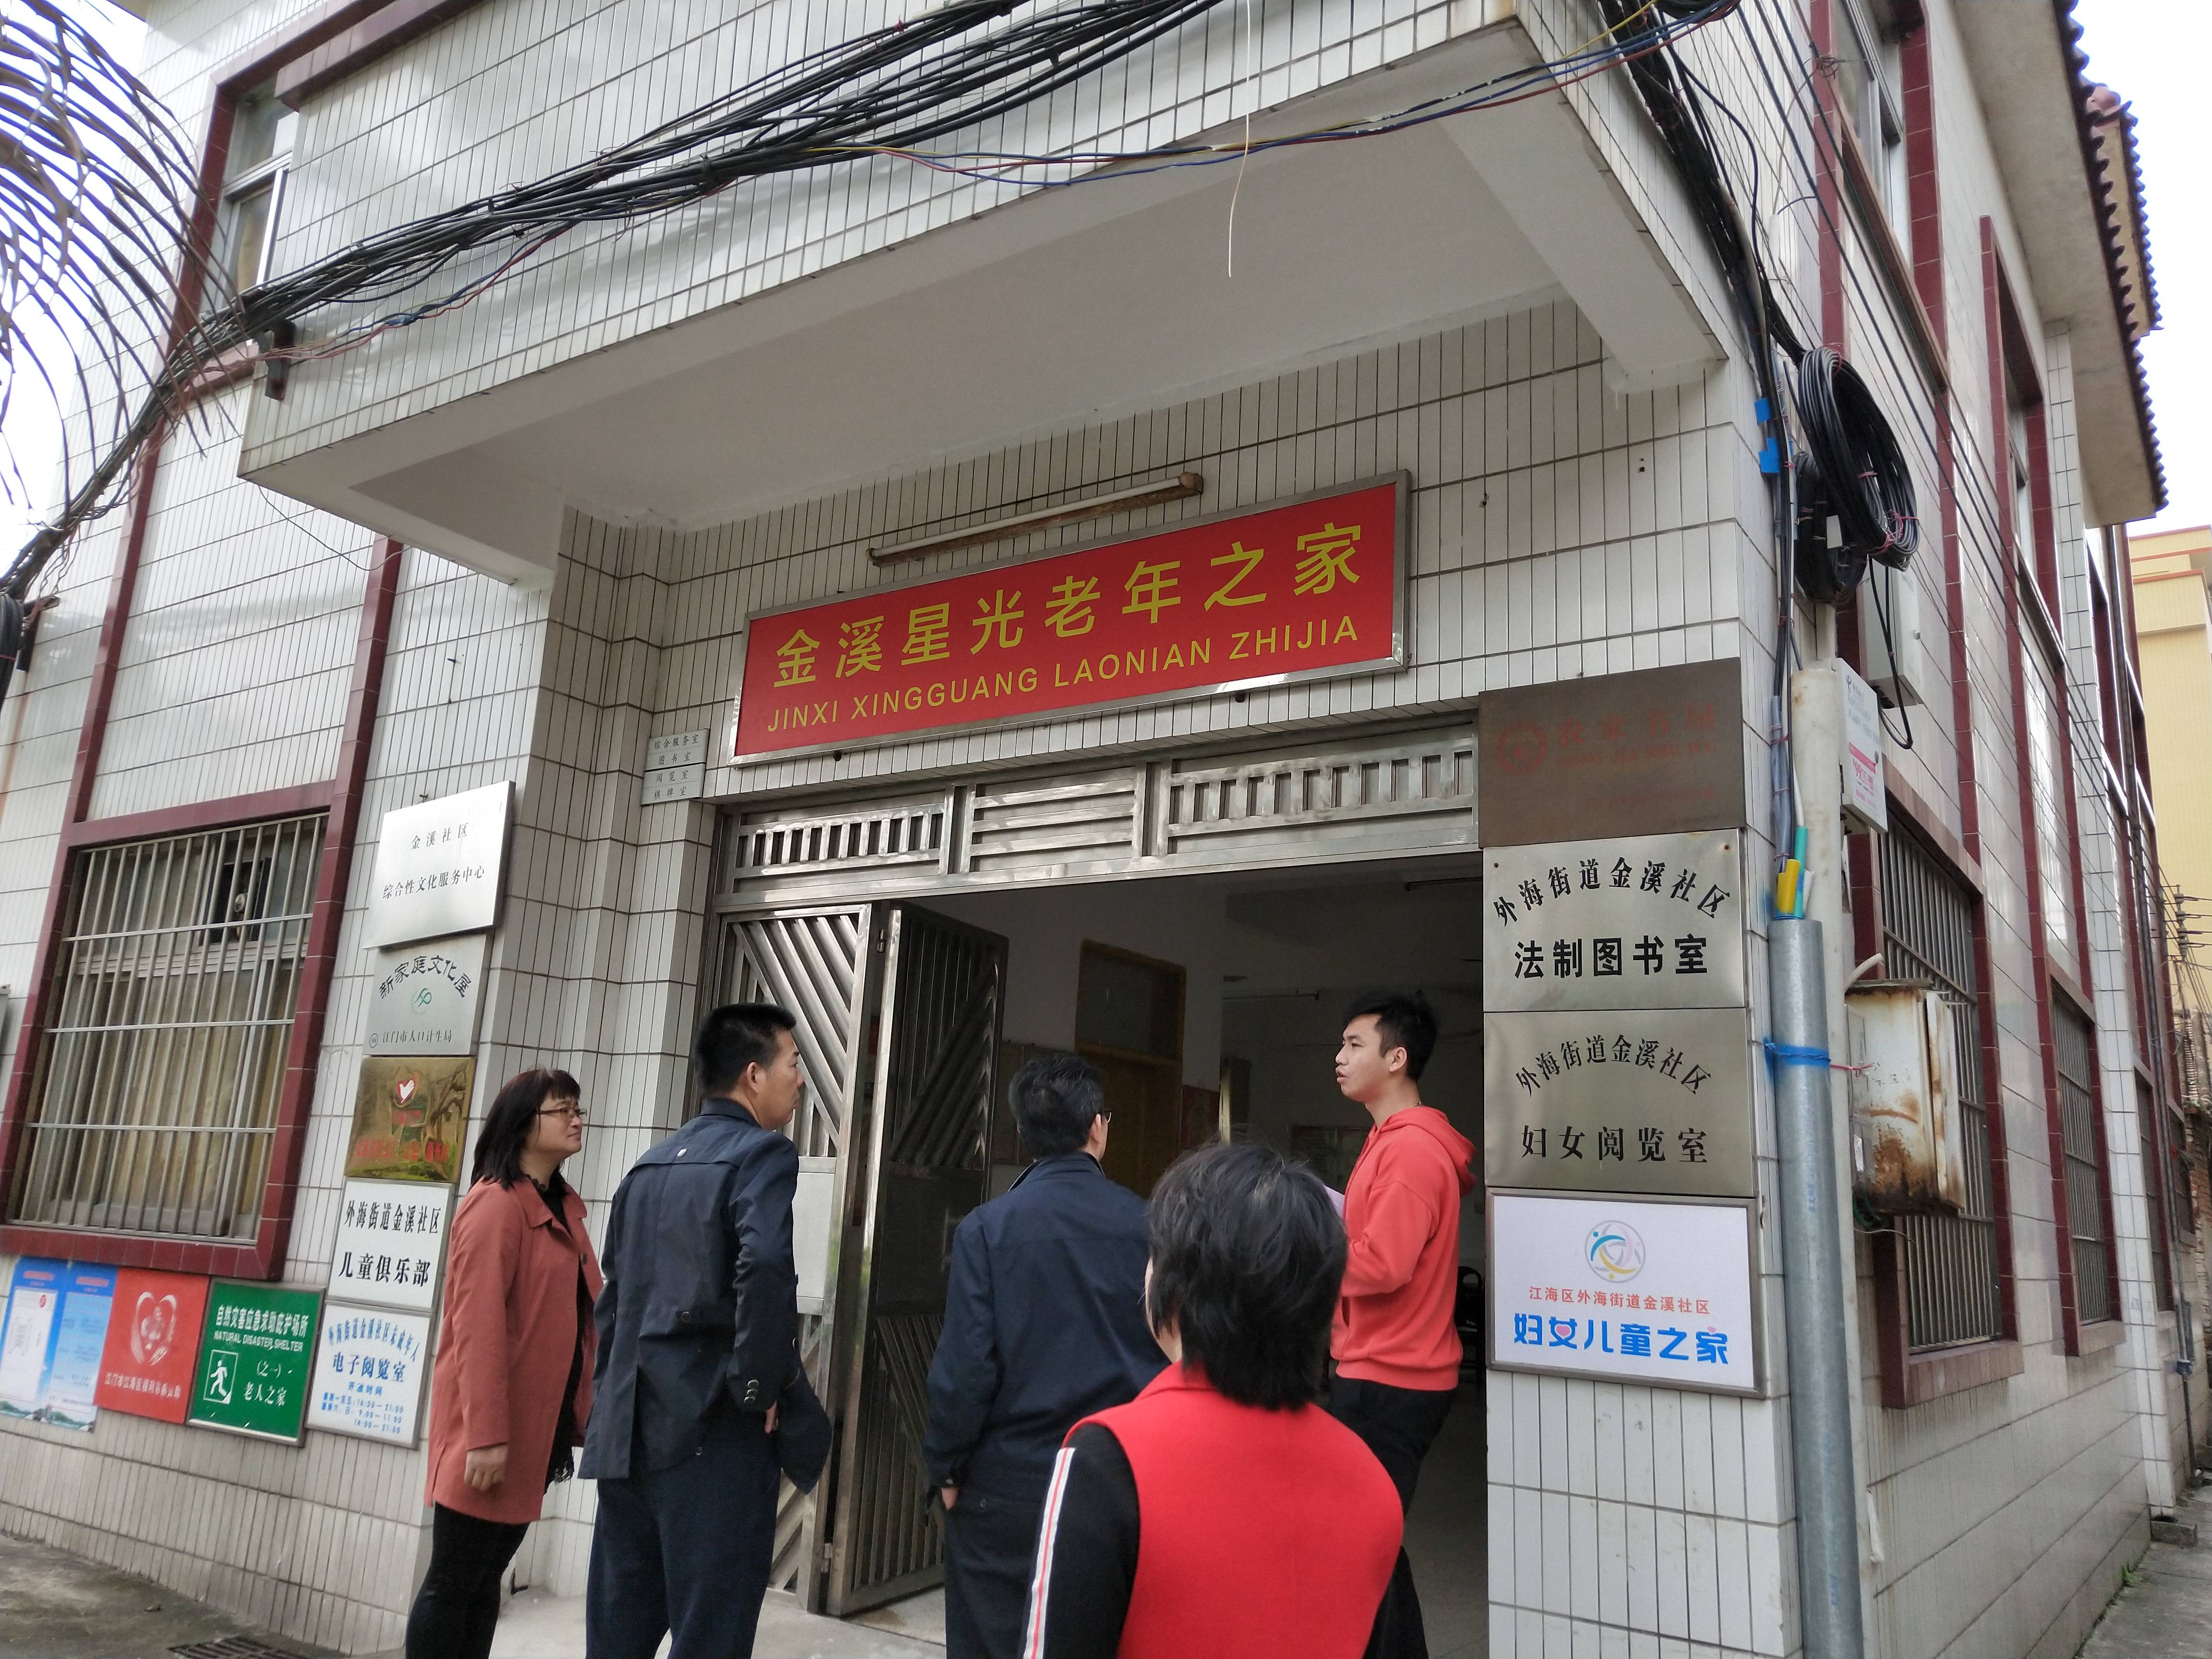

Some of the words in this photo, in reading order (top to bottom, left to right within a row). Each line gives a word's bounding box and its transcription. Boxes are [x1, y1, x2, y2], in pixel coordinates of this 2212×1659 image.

[773, 522, 1362, 689] 金溪星光老年之家
[768, 700, 838, 732] JINXI
[851, 668, 1039, 720] XINGGUANG
[1055, 638, 1212, 687] LAONIAN
[1229, 614, 1358, 660] ZHIJIA
[659, 752, 691, 765] 图书室
[656, 770, 688, 783] 阅览室
[410, 822, 469, 850] 金溪社区
[383, 865, 484, 899] 综合性文化服务中心
[1493, 856, 1730, 927] 外海街道金溪社区
[1515, 934, 1707, 978] 法制图书室
[379, 955, 471, 999] 新家庭文化屋
[383, 1030, 452, 1043] 江门市人口计生局
[1515, 1034, 1711, 1096] 外海街道金溪社区
[1521, 1125, 1707, 1163] 妇女阅览室
[344, 1200, 441, 1234] 外海街道金溪社区
[338, 1251, 431, 1286] 儿童俱乐部
[1529, 1286, 1710, 1314] 江海区外海街道金溪社区
[214, 1331, 240, 1343] NATURAL
[274, 1339, 303, 1352] SHELTER
[1514, 1312, 1728, 1365] 妇女儿童之家
[333, 1352, 405, 1382] 电子阅览室
[243, 1382, 287, 1407] 老人之家
